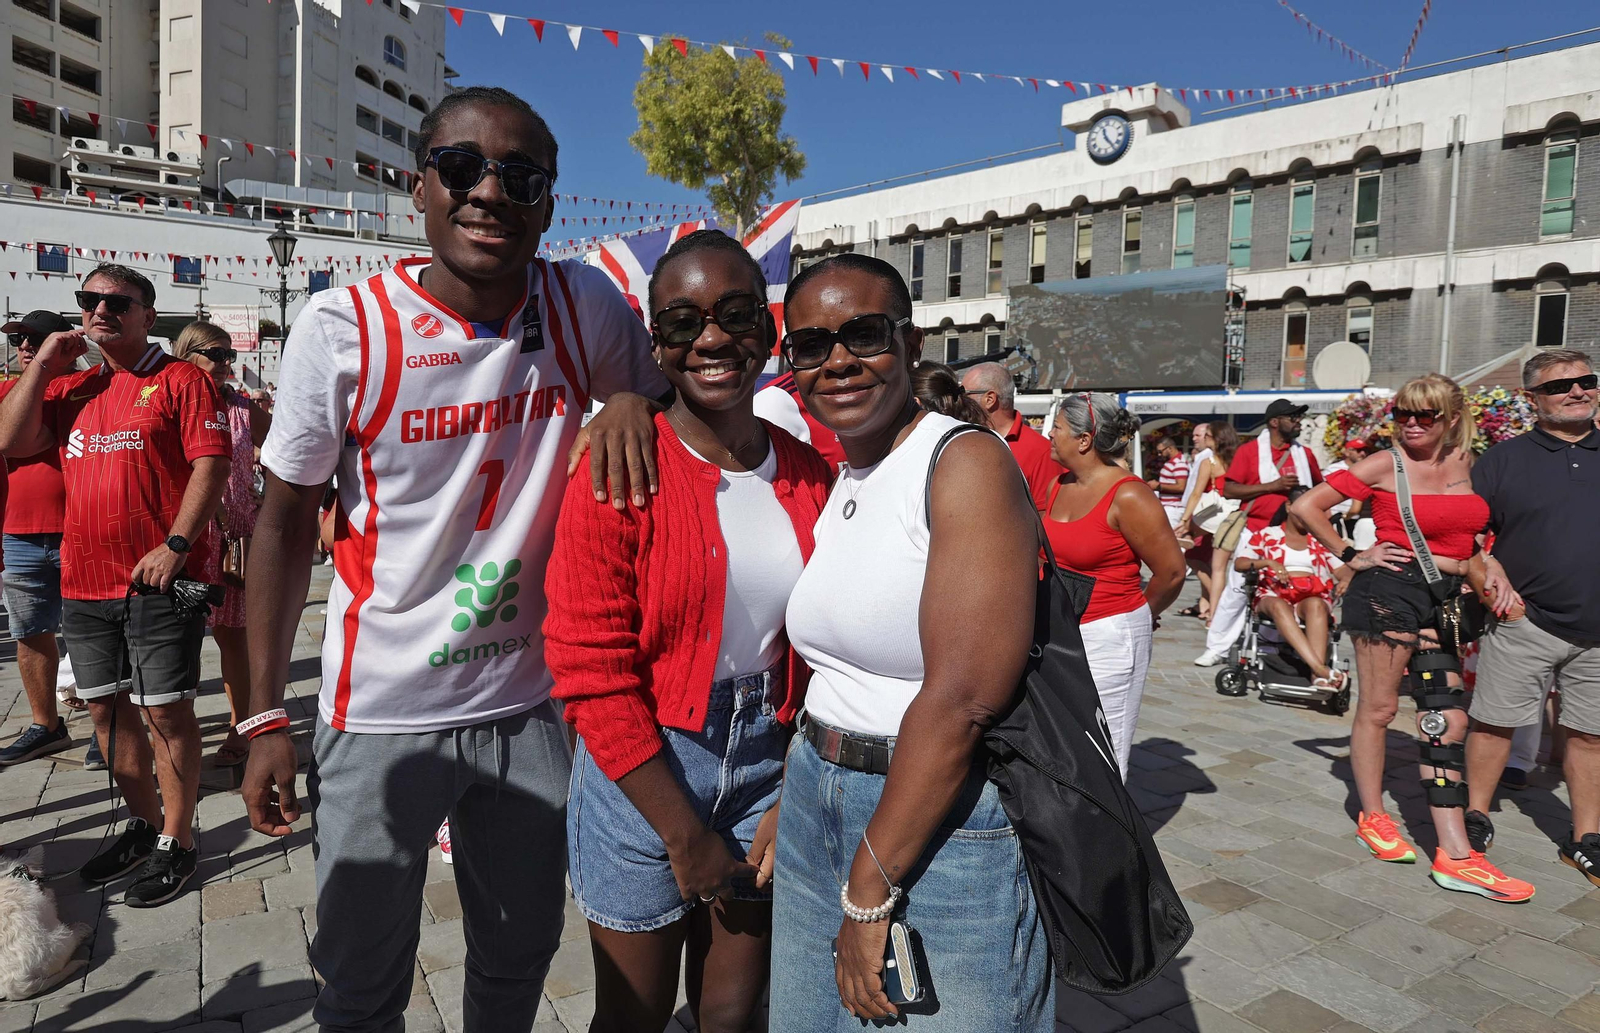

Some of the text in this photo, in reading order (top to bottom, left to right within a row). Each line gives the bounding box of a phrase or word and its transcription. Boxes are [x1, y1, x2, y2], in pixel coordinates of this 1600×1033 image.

[230, 333, 256, 342] OLDING
[405, 351, 463, 369] GABBA
[400, 384, 566, 444] GIBRALTAR
[89, 429, 140, 444] standard
[88, 439, 144, 454] chartered
[1402, 506, 1439, 581] MICHAEL KORS
[428, 633, 532, 668] damex
